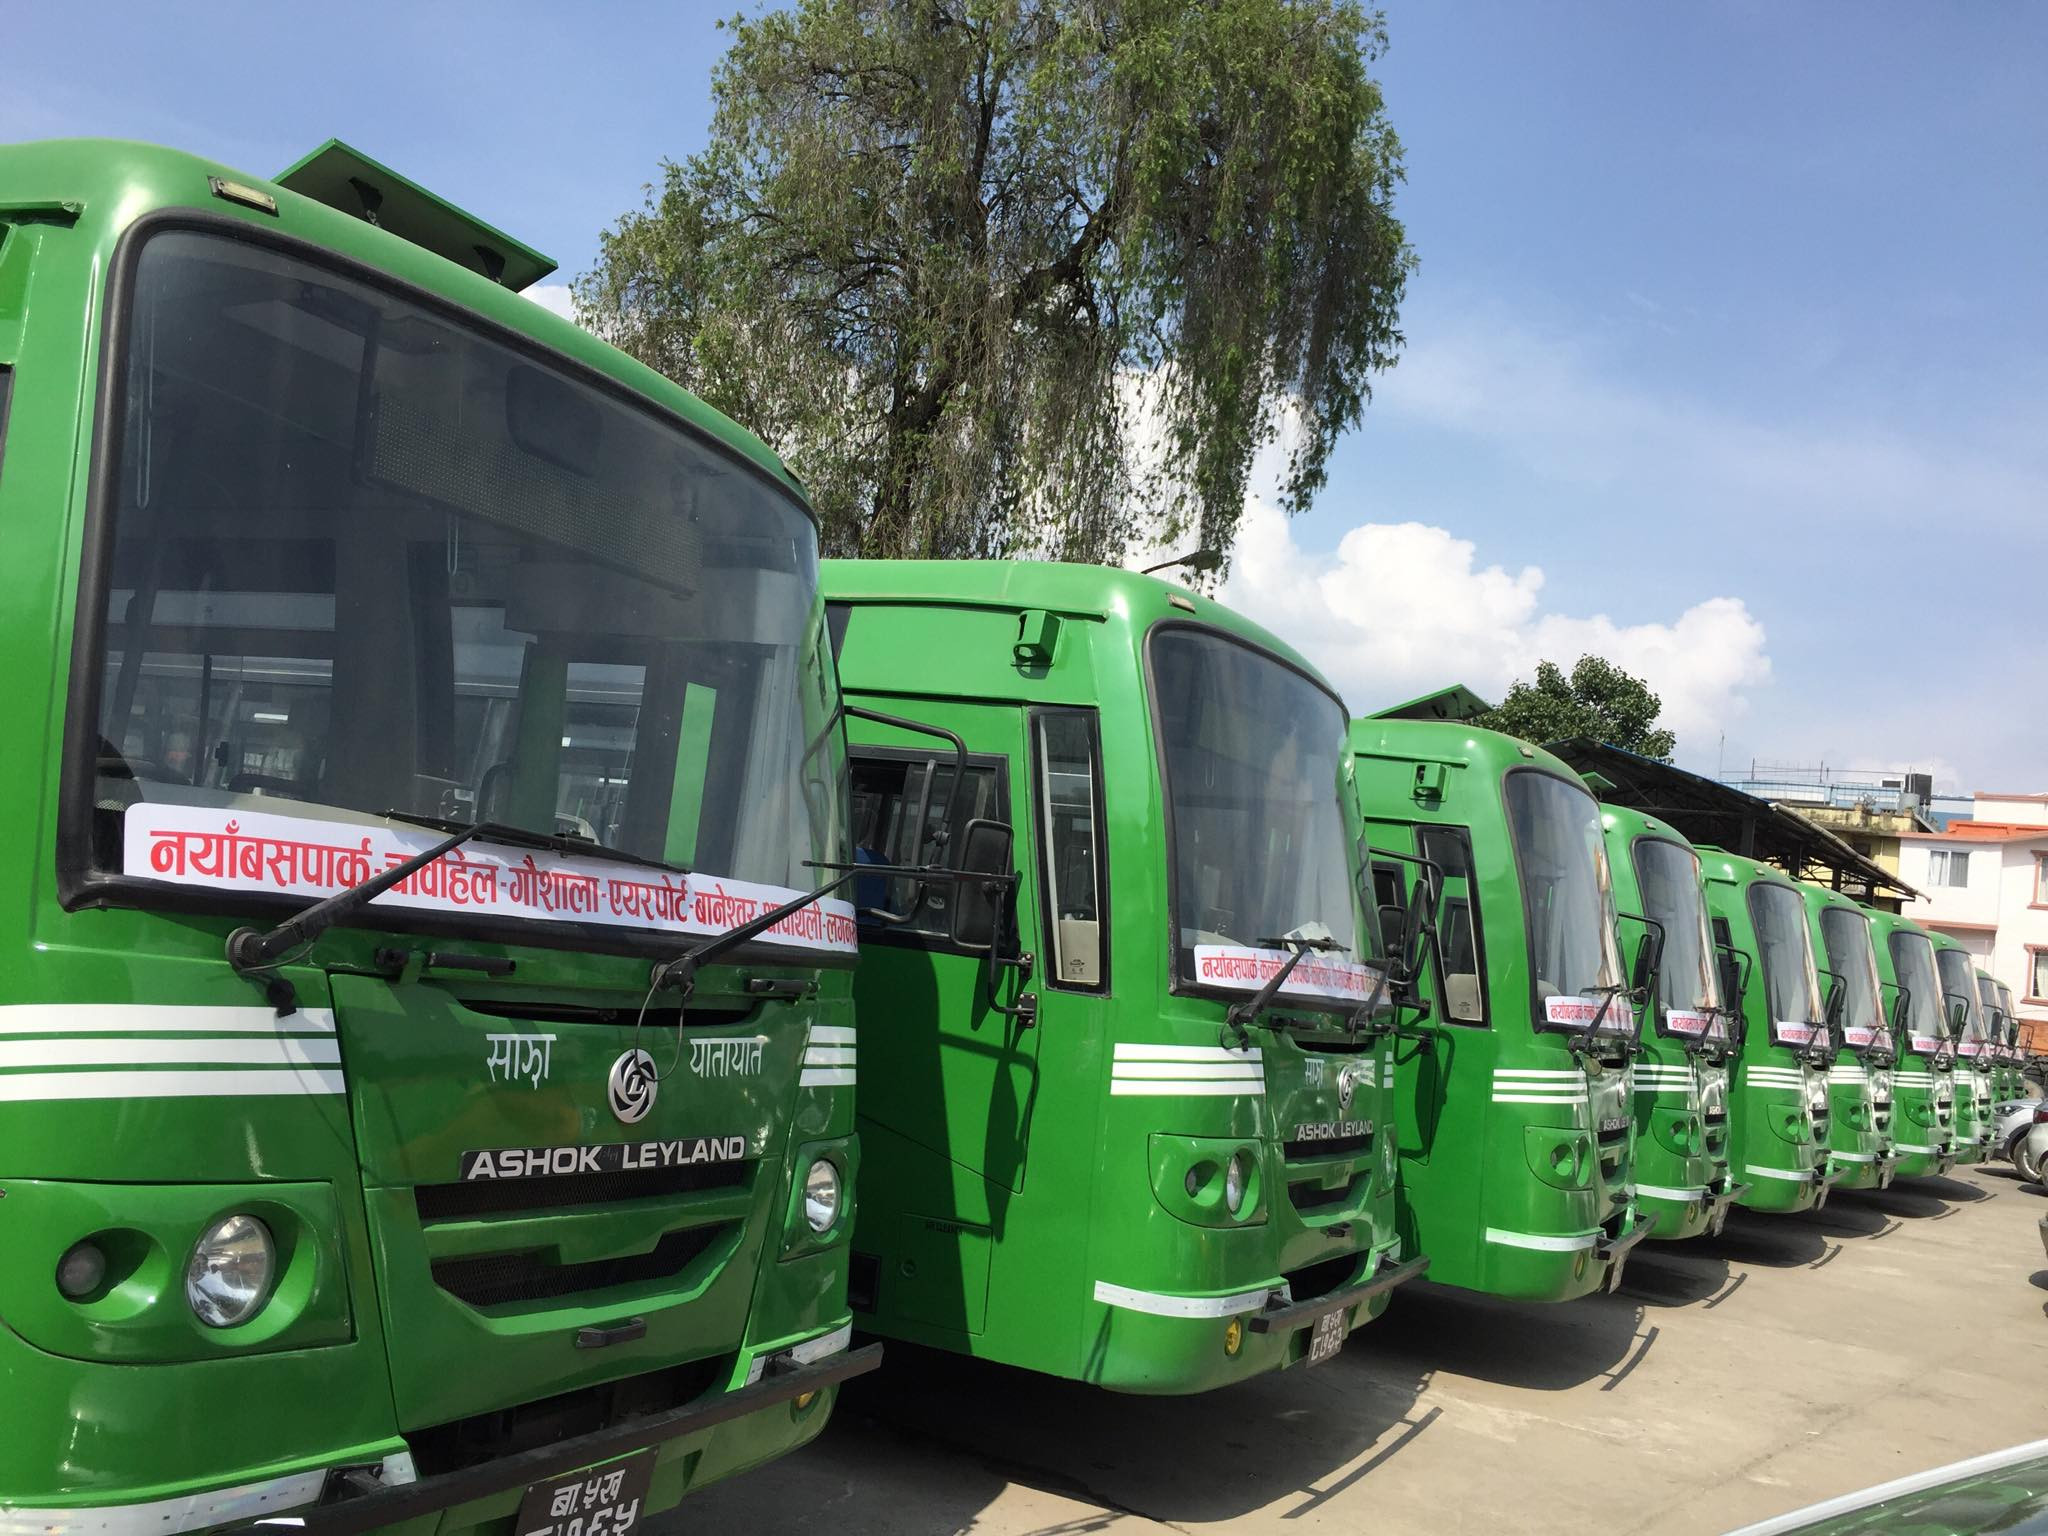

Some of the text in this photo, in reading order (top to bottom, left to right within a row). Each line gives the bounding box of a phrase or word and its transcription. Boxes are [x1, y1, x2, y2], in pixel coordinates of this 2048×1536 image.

[690, 1037, 766, 1078] यातायात
[1297, 1120, 1374, 1141] ASHOK LEYLAND
[467, 1136, 746, 1180] ASHOK LEYLAND
